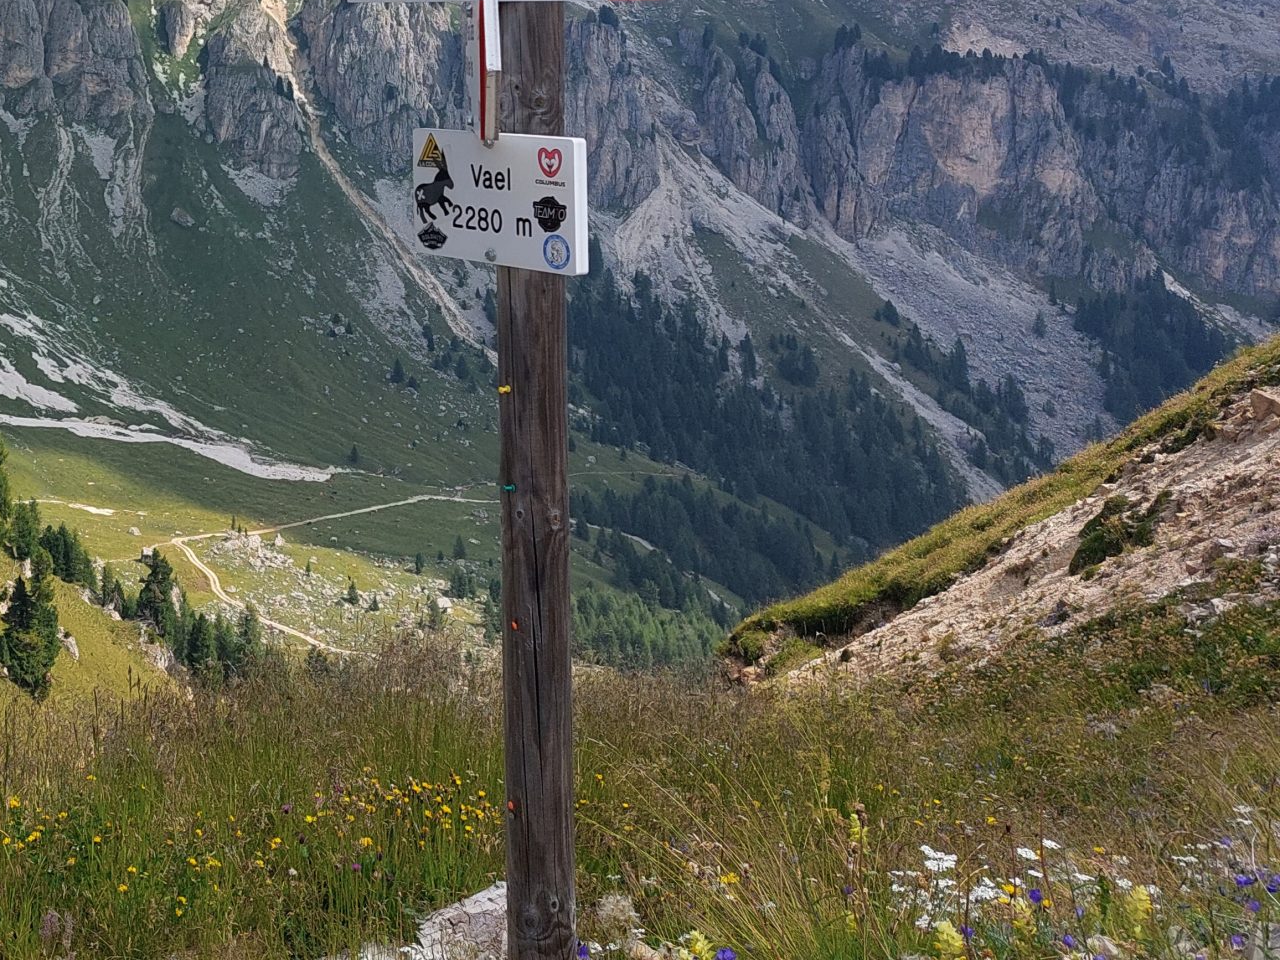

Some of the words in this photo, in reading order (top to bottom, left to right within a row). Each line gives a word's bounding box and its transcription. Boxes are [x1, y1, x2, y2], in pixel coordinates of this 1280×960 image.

[470, 163, 511, 191] Vael
[535, 178, 566, 188] COLUMBUS
[452, 204, 503, 233] 2280
[515, 216, 533, 237] m
